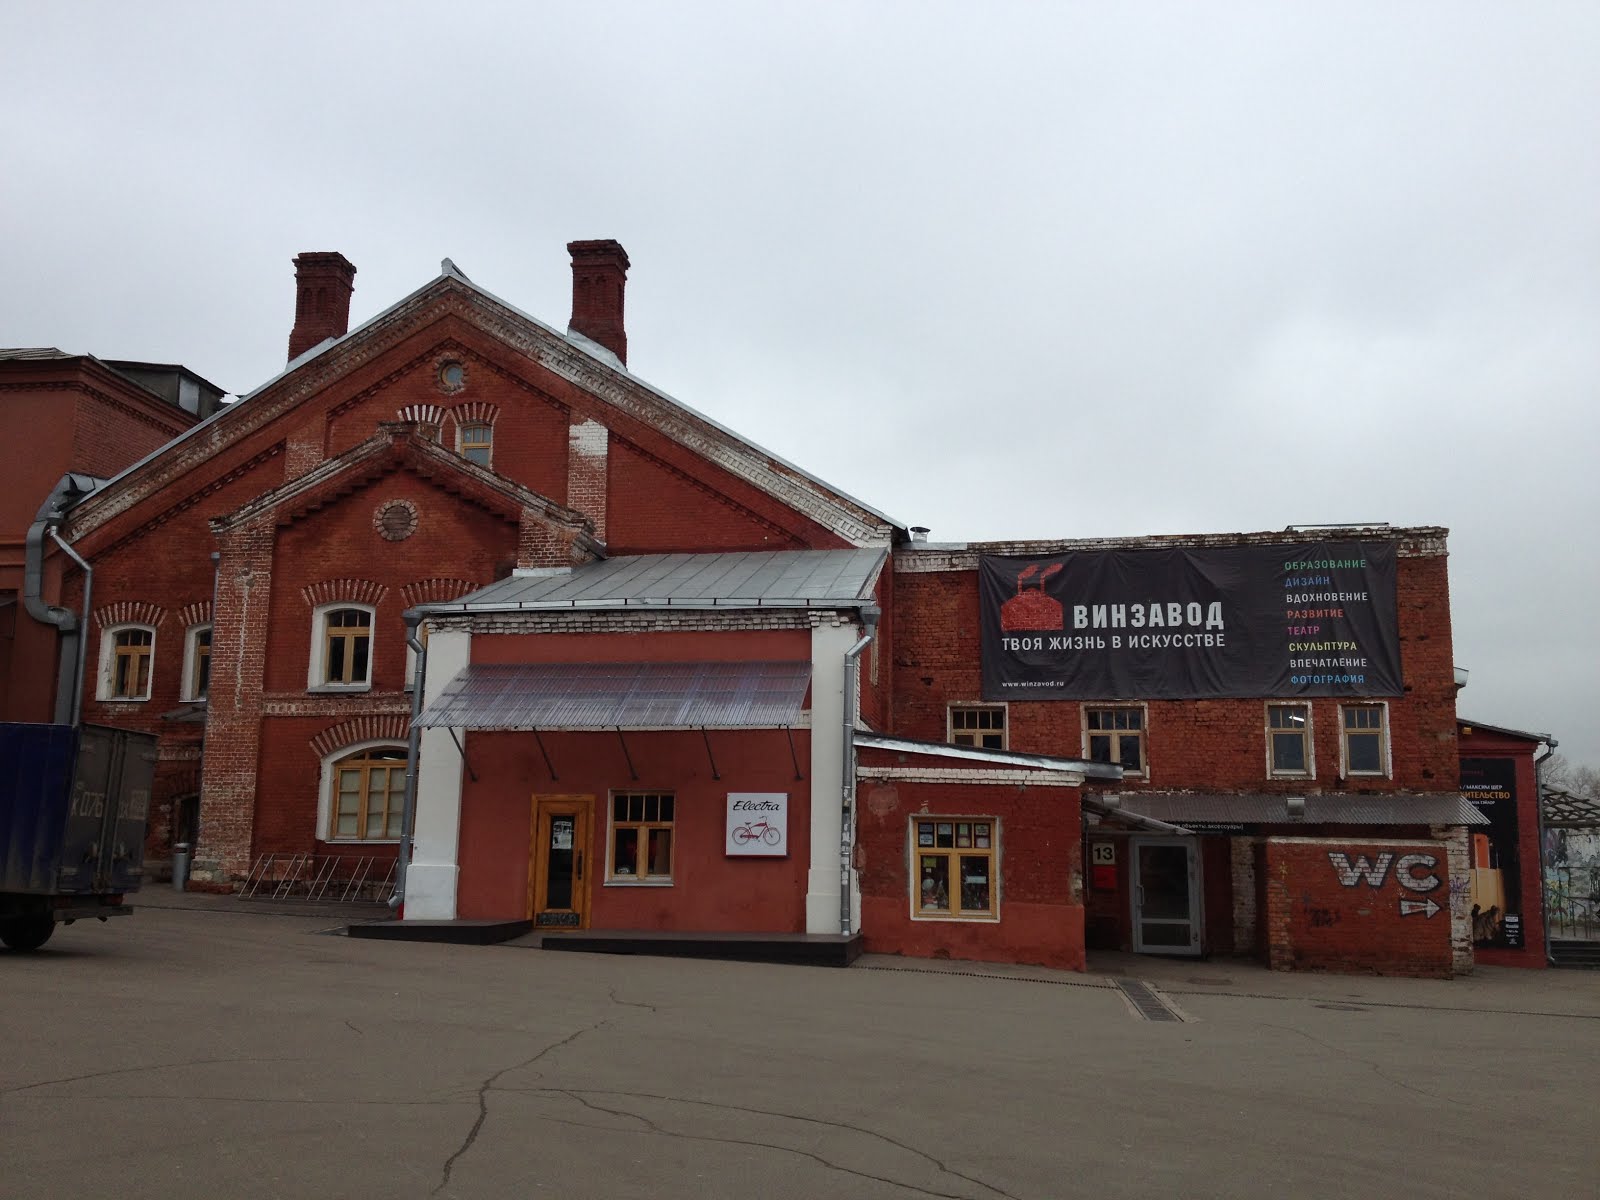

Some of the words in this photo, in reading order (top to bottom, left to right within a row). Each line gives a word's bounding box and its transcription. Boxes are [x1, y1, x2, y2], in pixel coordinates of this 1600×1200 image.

[1284, 559, 1367, 571] ОБРАЗОВАНИЕ
[1285, 575, 1330, 588] ДИЗАЙН
[1286, 592, 1368, 604] ВДОХНОВЕНИЕ
[1073, 601, 1225, 631] ВИНЗАВОД
[1287, 608, 1344, 619] РАЗВИТИЕ
[1288, 626, 1320, 636] ТЕАТР
[1002, 637, 1043, 651] ТВОЯ
[1049, 635, 1106, 650] ЖИЗНЬ
[1112, 635, 1122, 649] В
[1128, 633, 1226, 649] ИСКУССТВЕ
[1289, 641, 1358, 652] СКУЛЬПТУРА
[1290, 658, 1367, 668] ВПЕЧАТЛЕНИЕ
[1001, 680, 1065, 688] www.winzavod.ru
[1291, 674, 1365, 685] ФОТОГРАФИЯ
[732, 800, 780, 811] Electra
[1094, 847, 1113, 860] 13
[1328, 852, 1442, 892] WC
